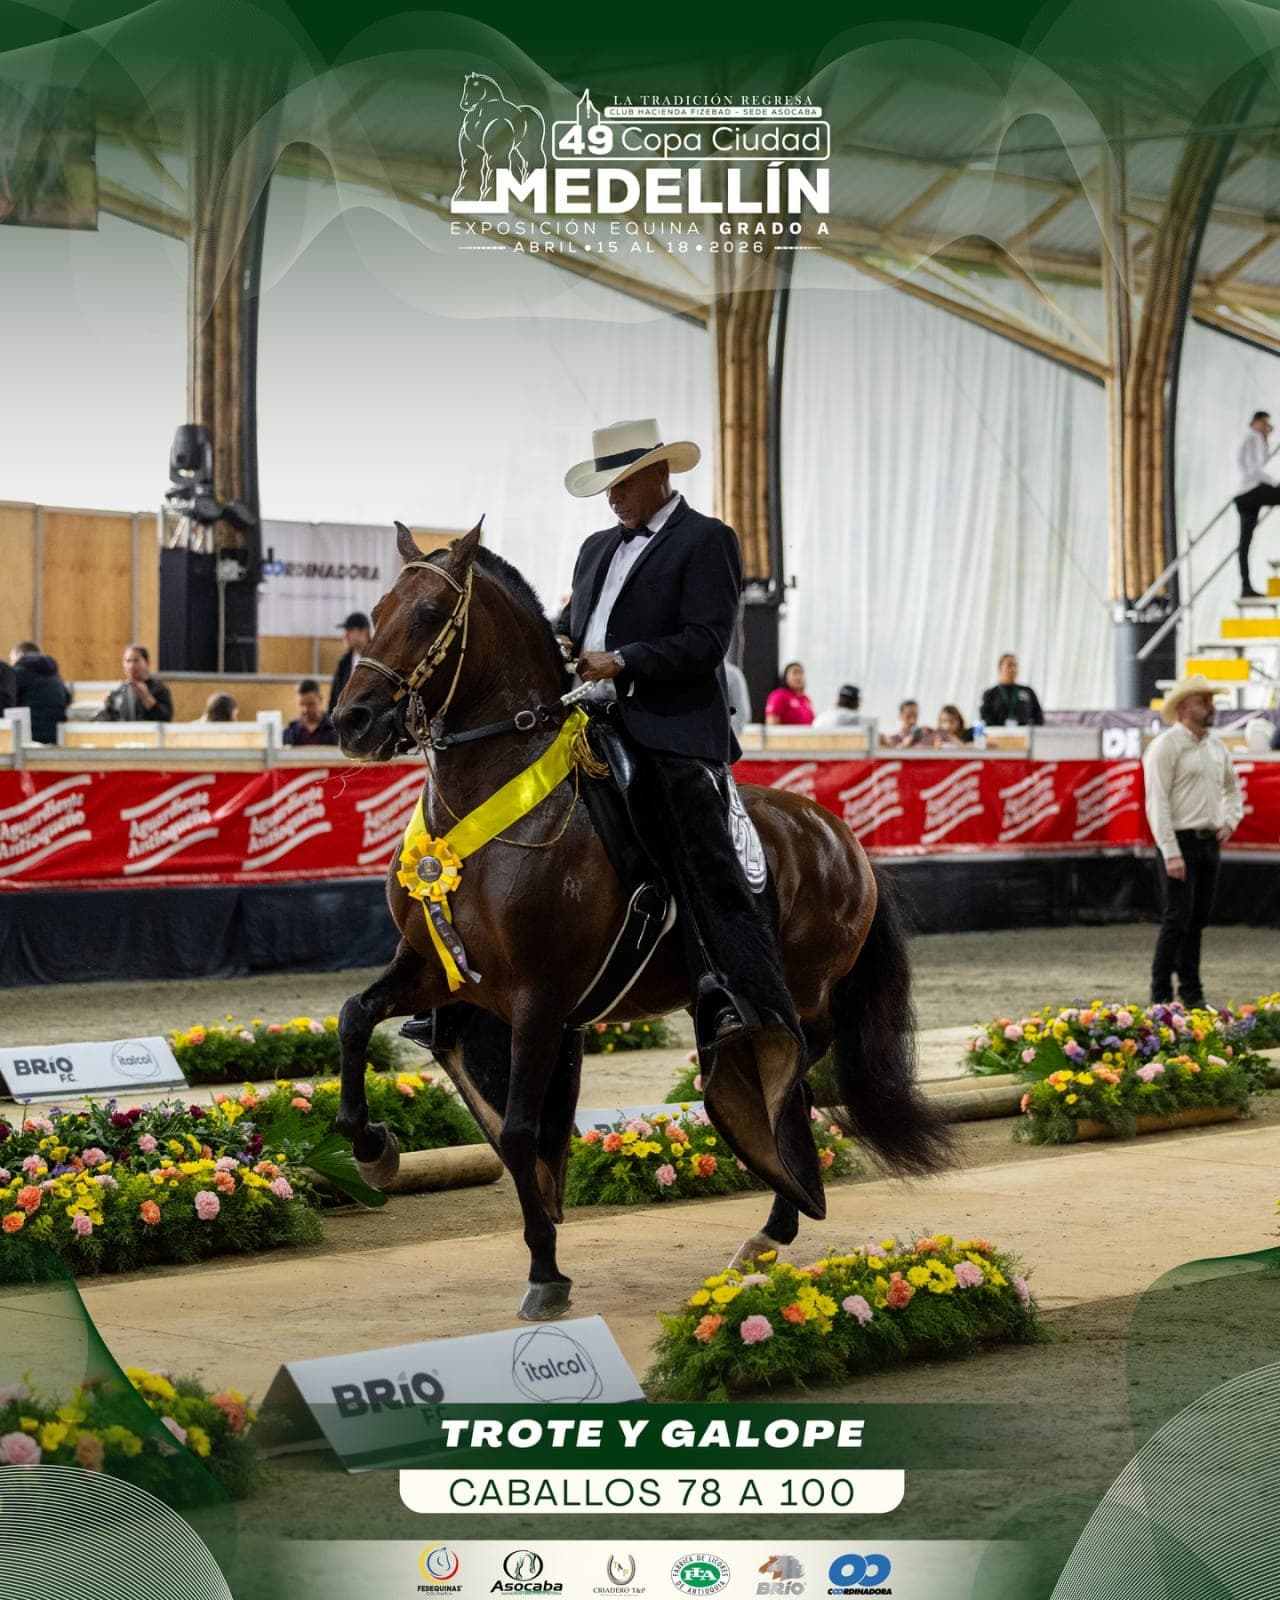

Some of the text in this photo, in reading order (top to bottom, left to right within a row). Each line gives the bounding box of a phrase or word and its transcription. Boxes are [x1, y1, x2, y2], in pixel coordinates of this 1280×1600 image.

[117, 1051, 153, 1066] italcol
[59, 1073, 77, 1083] FC
[520, 1353, 587, 1383] italcol
